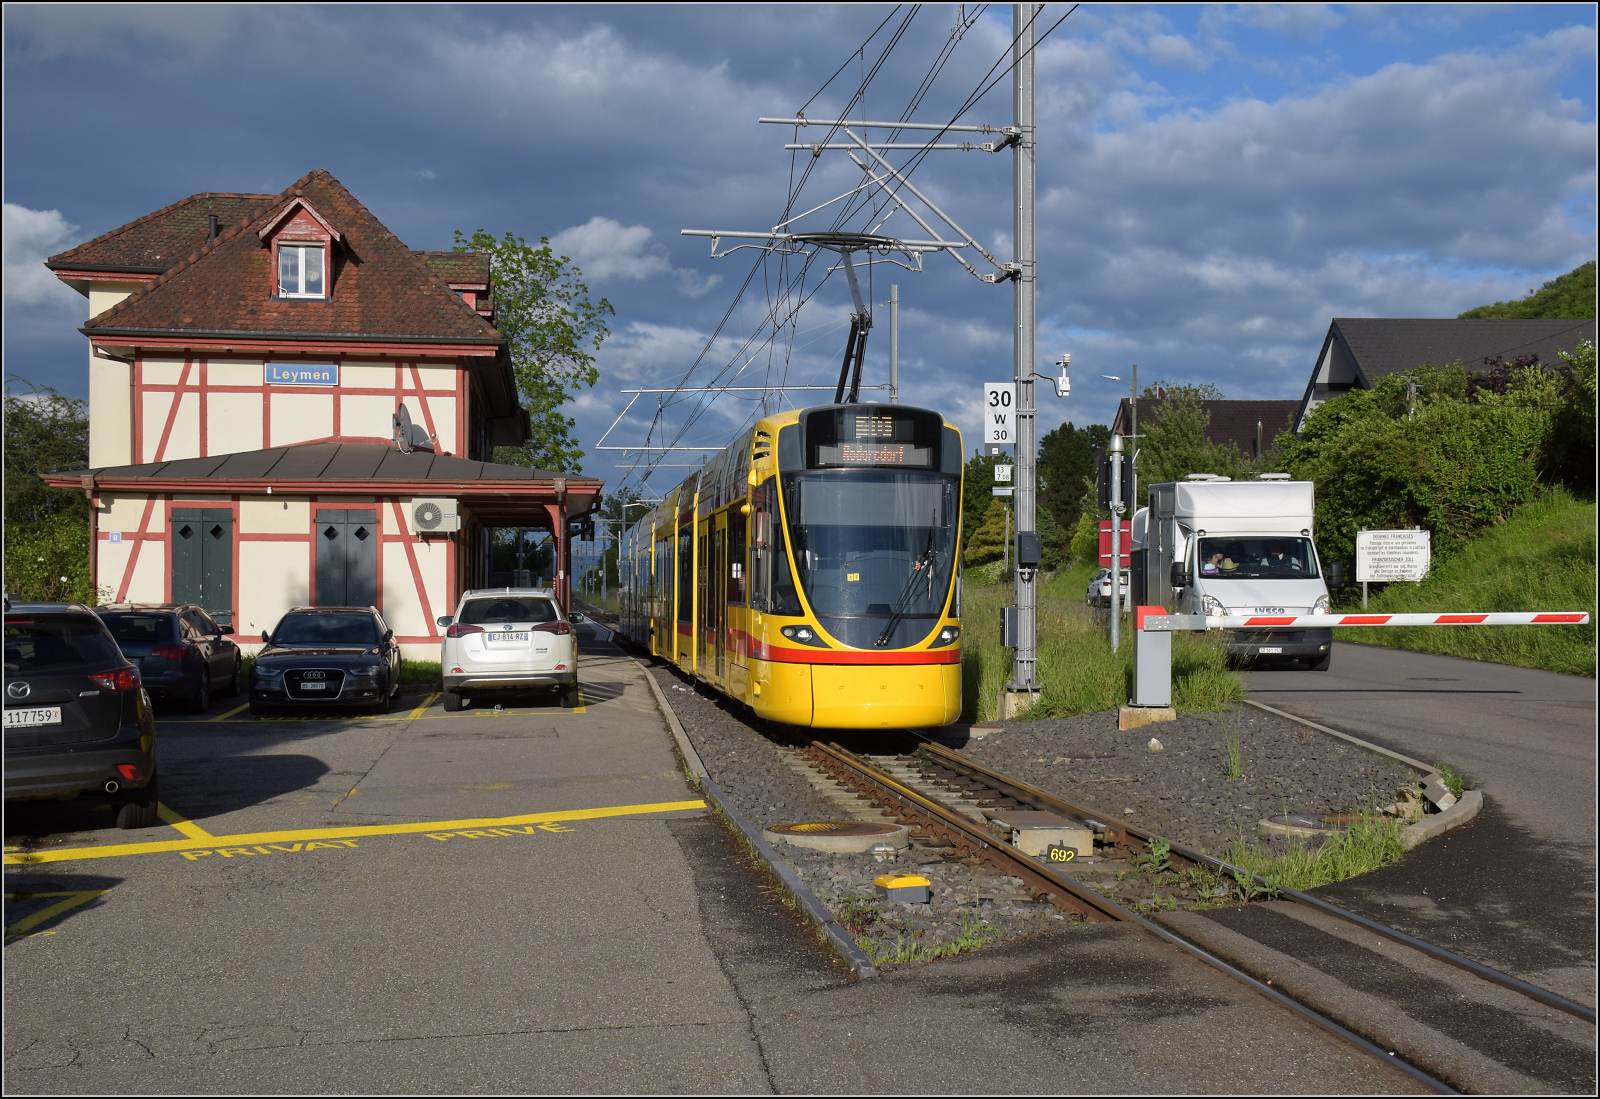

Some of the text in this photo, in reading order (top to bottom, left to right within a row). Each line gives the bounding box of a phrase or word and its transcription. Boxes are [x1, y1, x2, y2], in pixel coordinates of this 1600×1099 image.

[273, 367, 330, 383] Leymen
[989, 390, 1011, 407] 30
[994, 414, 1006, 425] W
[993, 429, 1007, 441] 30
[424, 821, 576, 843] PRIVÉ
[179, 838, 359, 861] PRIVAT
[1050, 848, 1075, 862] 692
